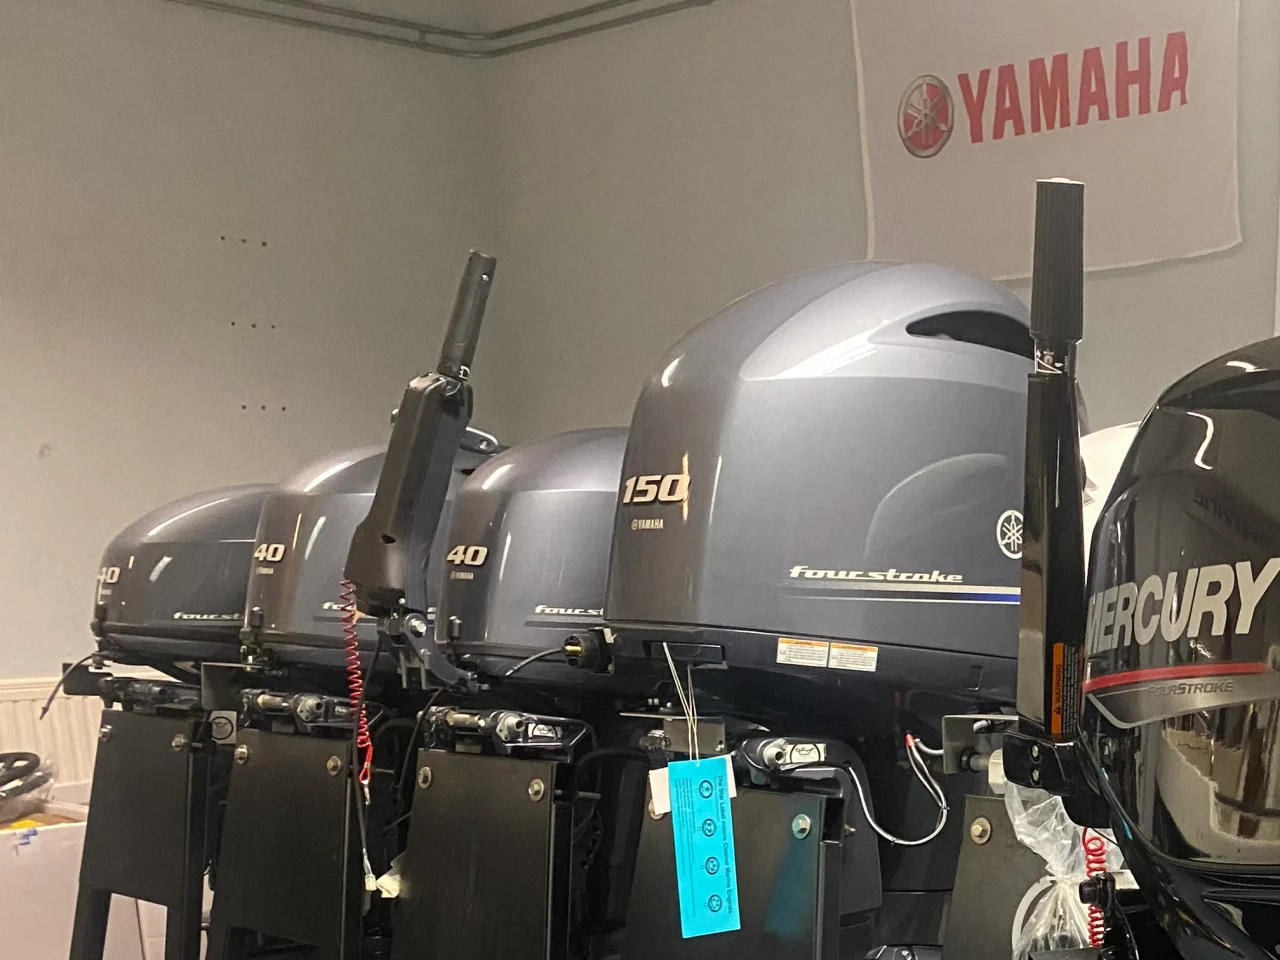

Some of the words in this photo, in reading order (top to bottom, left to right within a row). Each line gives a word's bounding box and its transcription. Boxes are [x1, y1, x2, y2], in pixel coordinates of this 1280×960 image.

[957, 31, 1189, 144] YAMAHA
[622, 473, 692, 504] 150
[638, 518, 664, 530] YAMAHA
[253, 543, 286, 562] 40
[446, 544, 488, 566] 40
